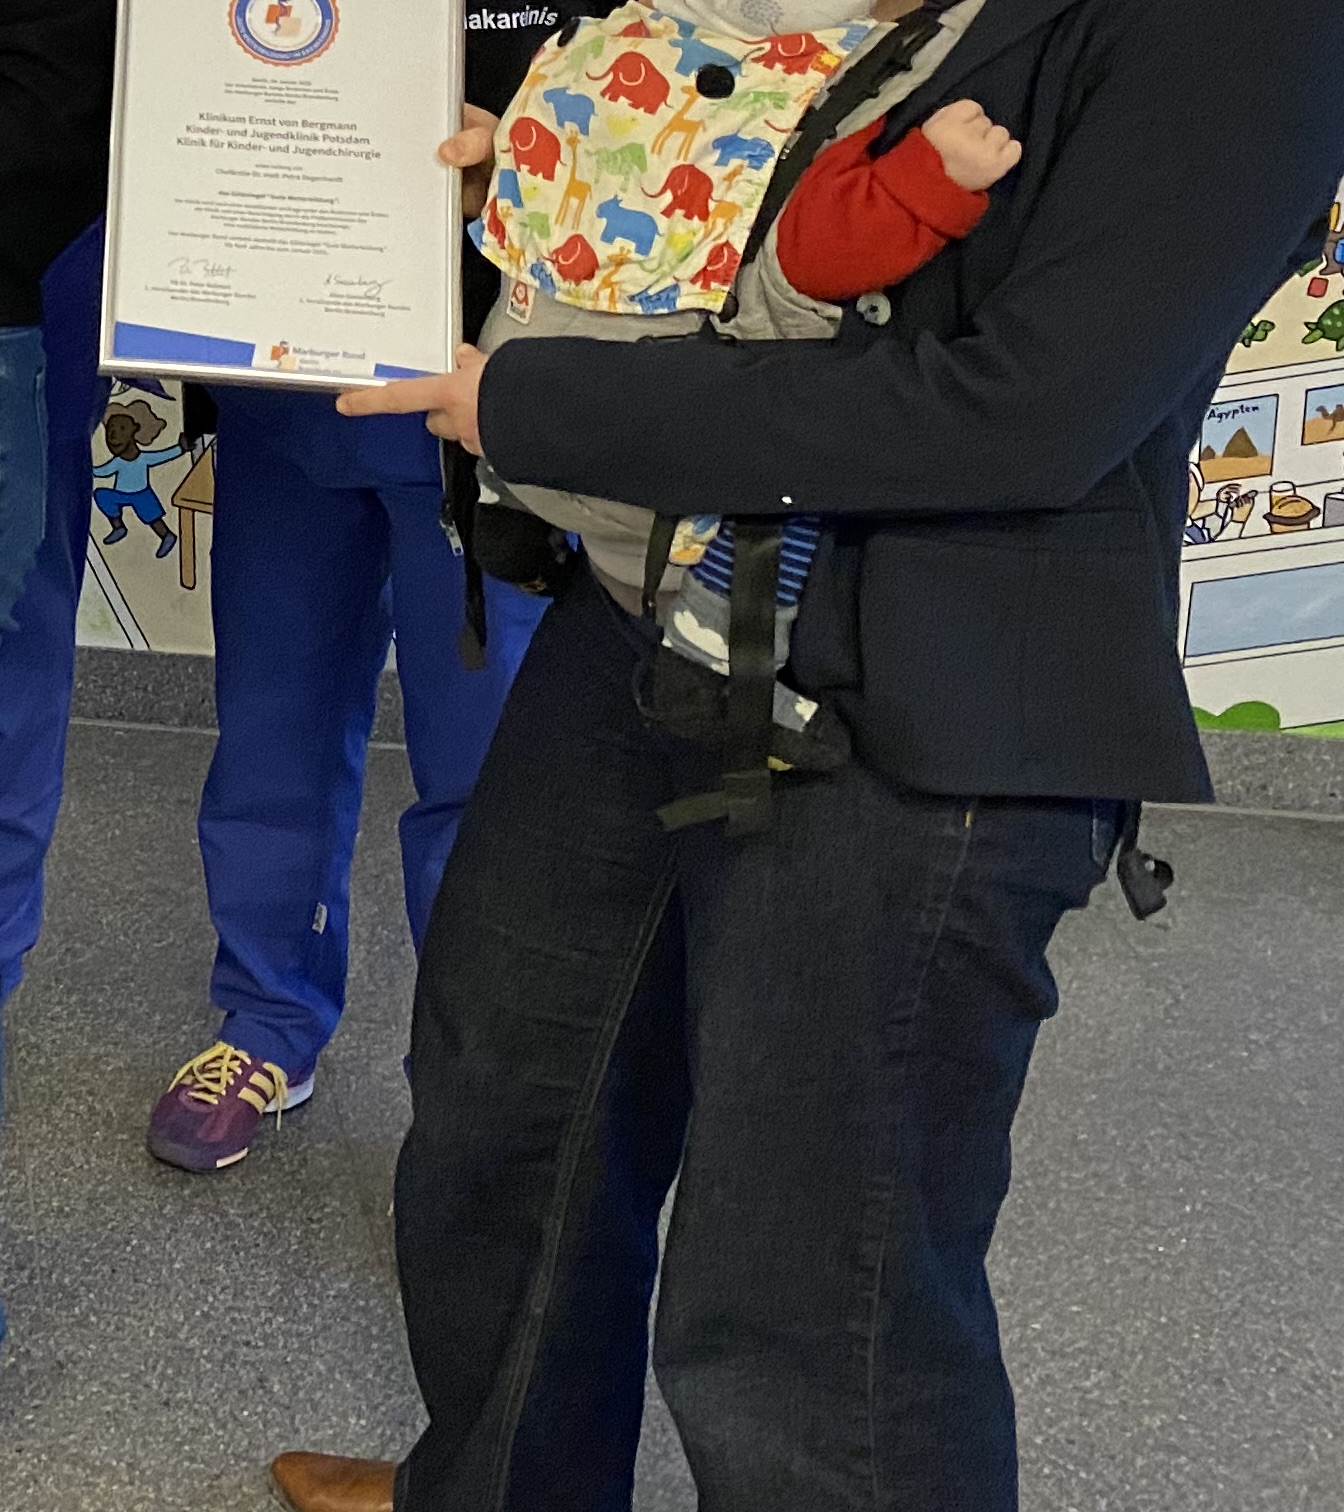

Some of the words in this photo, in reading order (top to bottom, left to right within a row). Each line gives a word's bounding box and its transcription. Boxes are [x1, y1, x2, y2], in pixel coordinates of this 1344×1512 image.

[198, 112, 247, 124] Klinikum
[248, 115, 276, 126] Ernst
[278, 119, 299, 127] von
[301, 119, 358, 131] Bergmann
[186, 124, 226, 135] Kinder-
[226, 128, 248, 137] und
[250, 129, 320, 141] Jugendklinik
[322, 133, 370, 145] Potsdam
[227, 140, 267, 151] Kinder-
[268, 144, 290, 154] und
[292, 145, 382, 160] Jugendchirurgie
